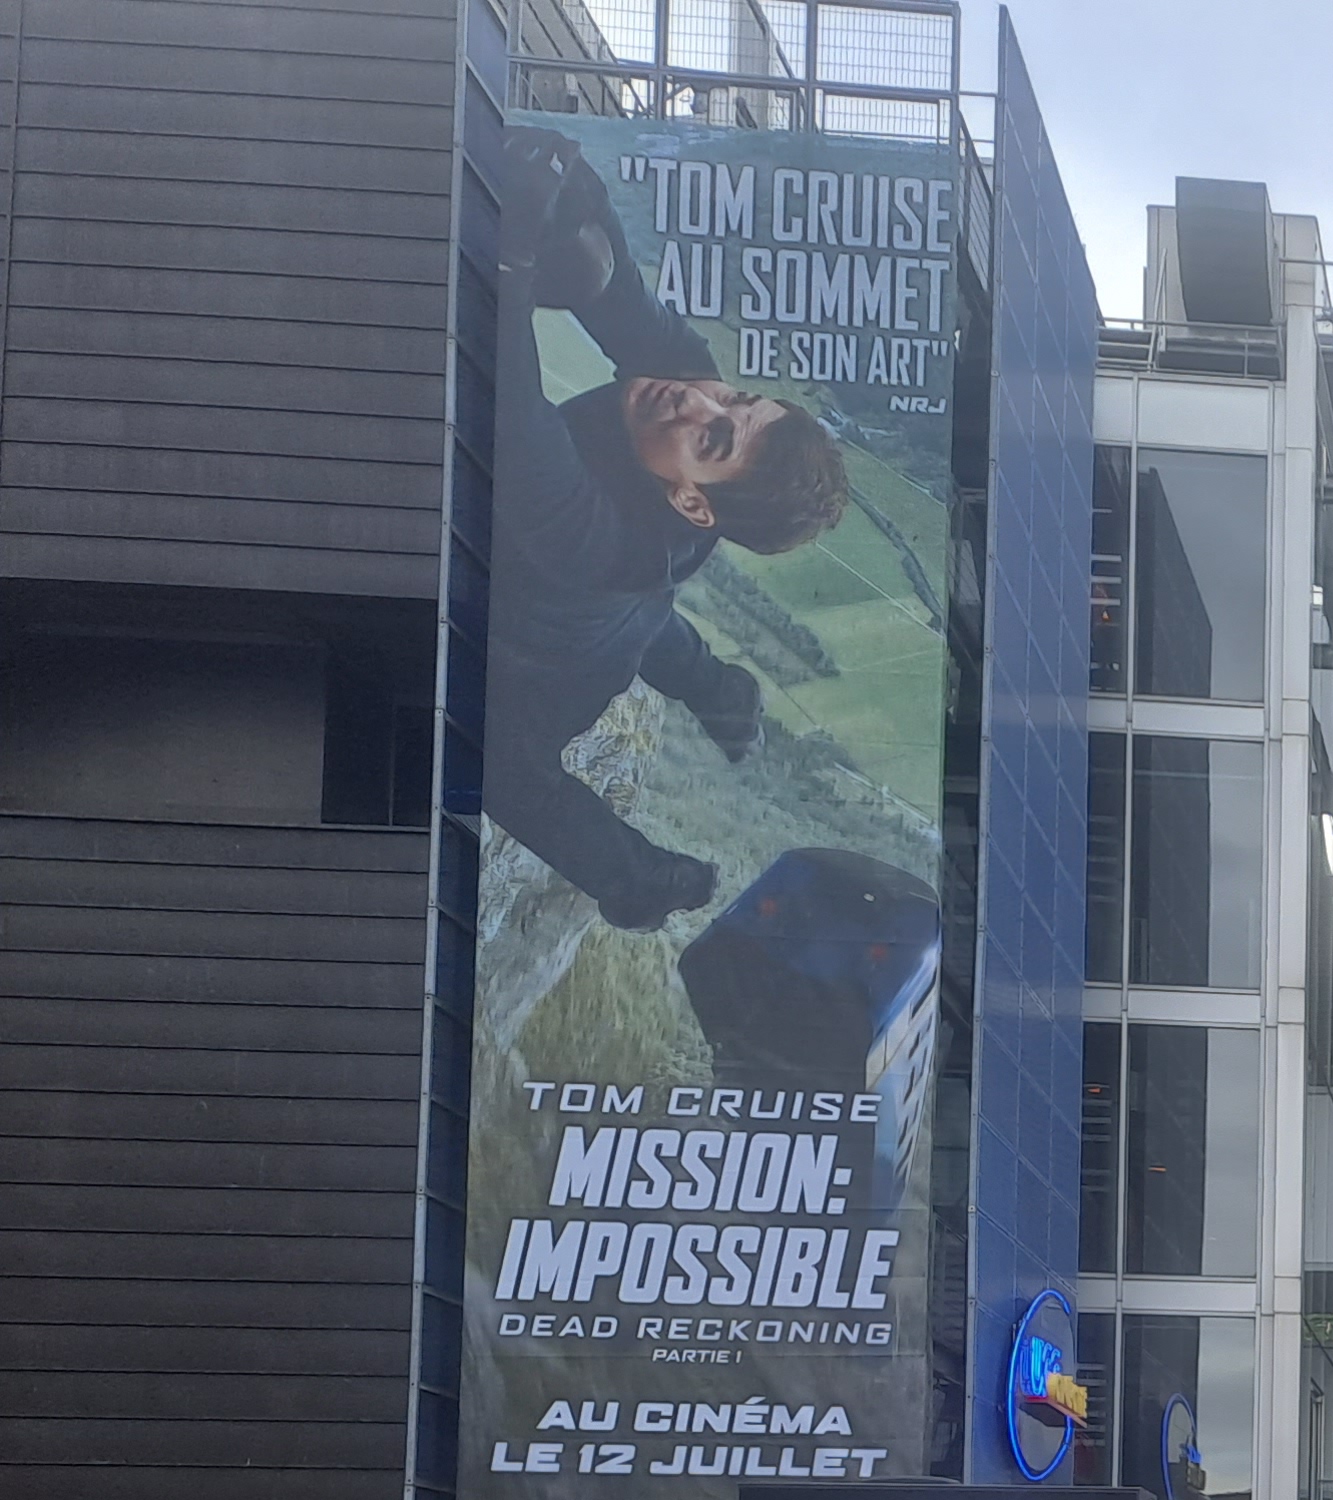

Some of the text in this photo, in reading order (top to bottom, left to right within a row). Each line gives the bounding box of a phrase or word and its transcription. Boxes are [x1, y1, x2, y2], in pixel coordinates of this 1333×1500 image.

[619, 155, 953, 253] "TOM CRUISE
[656, 239, 951, 333] AU SOMMET
[738, 327, 948, 388] DE SON ART"
[889, 394, 946, 415] NRJ
[522, 1082, 883, 1123] TOM CRUISE
[548, 1126, 853, 1215] MISSION:
[494, 1219, 900, 1310] IMPOSSIBLE
[499, 1314, 893, 1345] DEAD RECKONING
[651, 1349, 732, 1363] PARTIE
[536, 1396, 852, 1435] AU CINÉMA
[490, 1442, 887, 1478] LE 12 JUILLET
